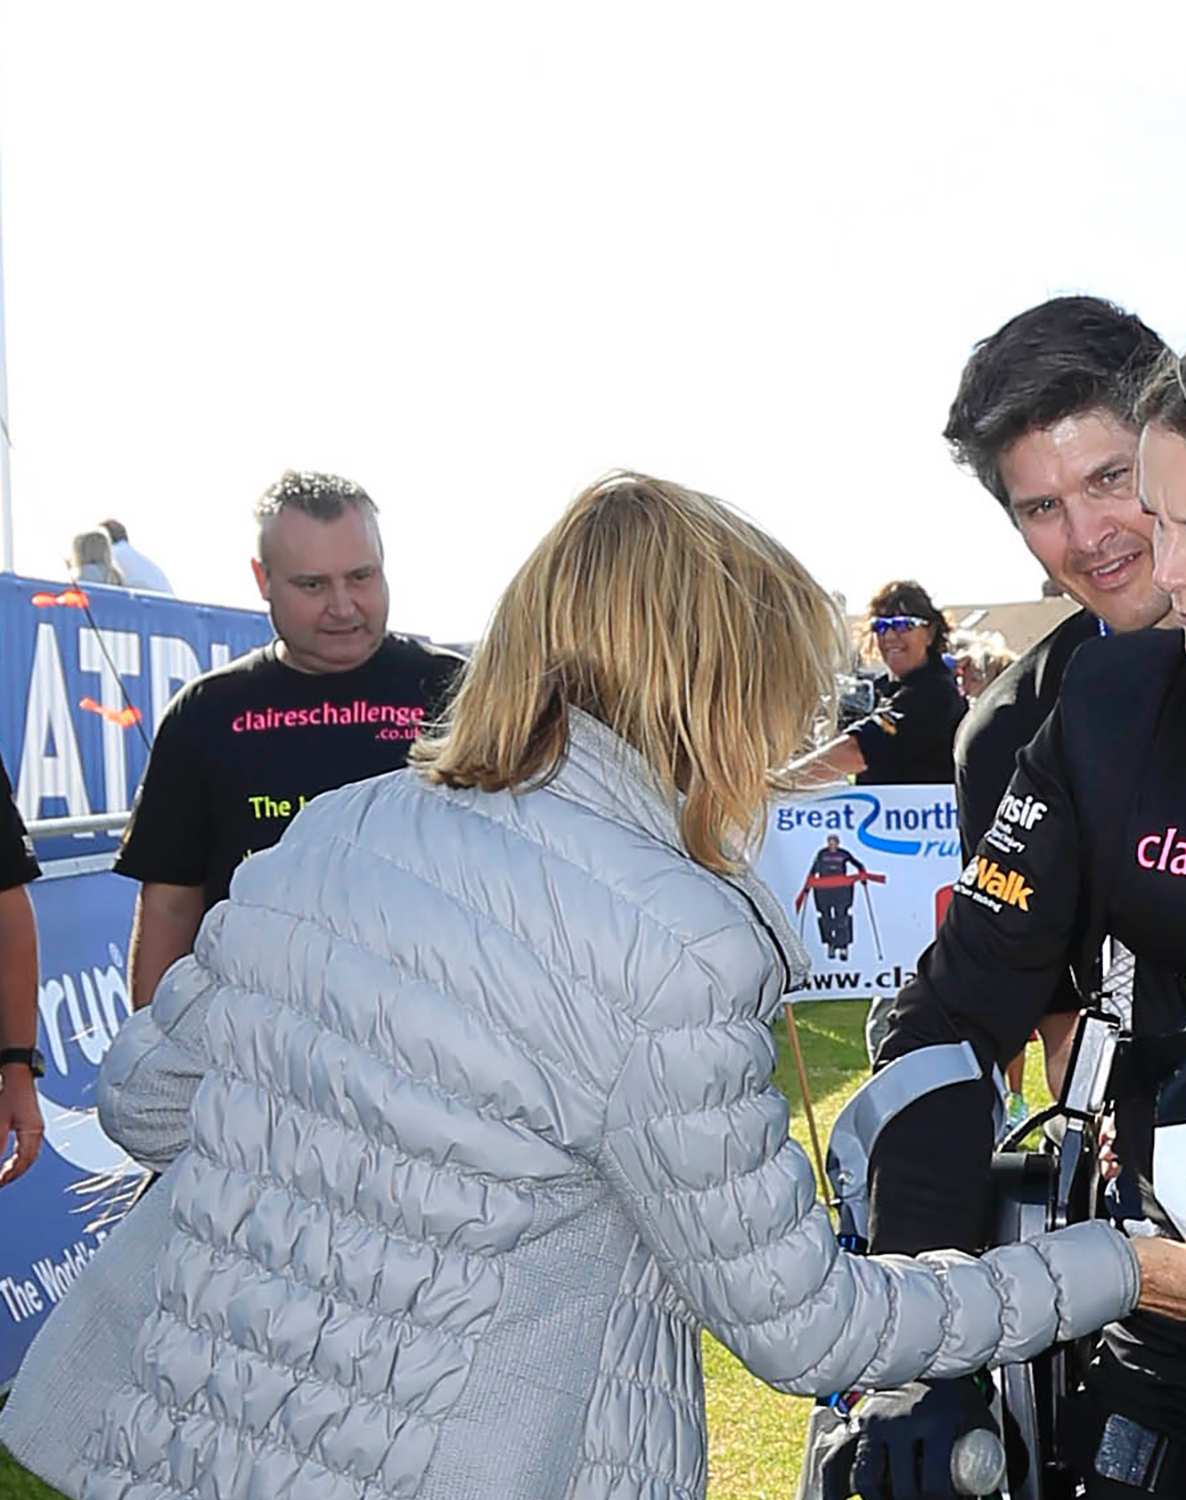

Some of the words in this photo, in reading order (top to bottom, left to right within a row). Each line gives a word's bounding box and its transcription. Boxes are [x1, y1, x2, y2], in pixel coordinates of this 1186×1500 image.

[232, 701, 425, 732] claireschallenge
[248, 797, 292, 818] The
[777, 804, 854, 831] great
[924, 840, 961, 857] ru
[0, 1276, 43, 1322] The
